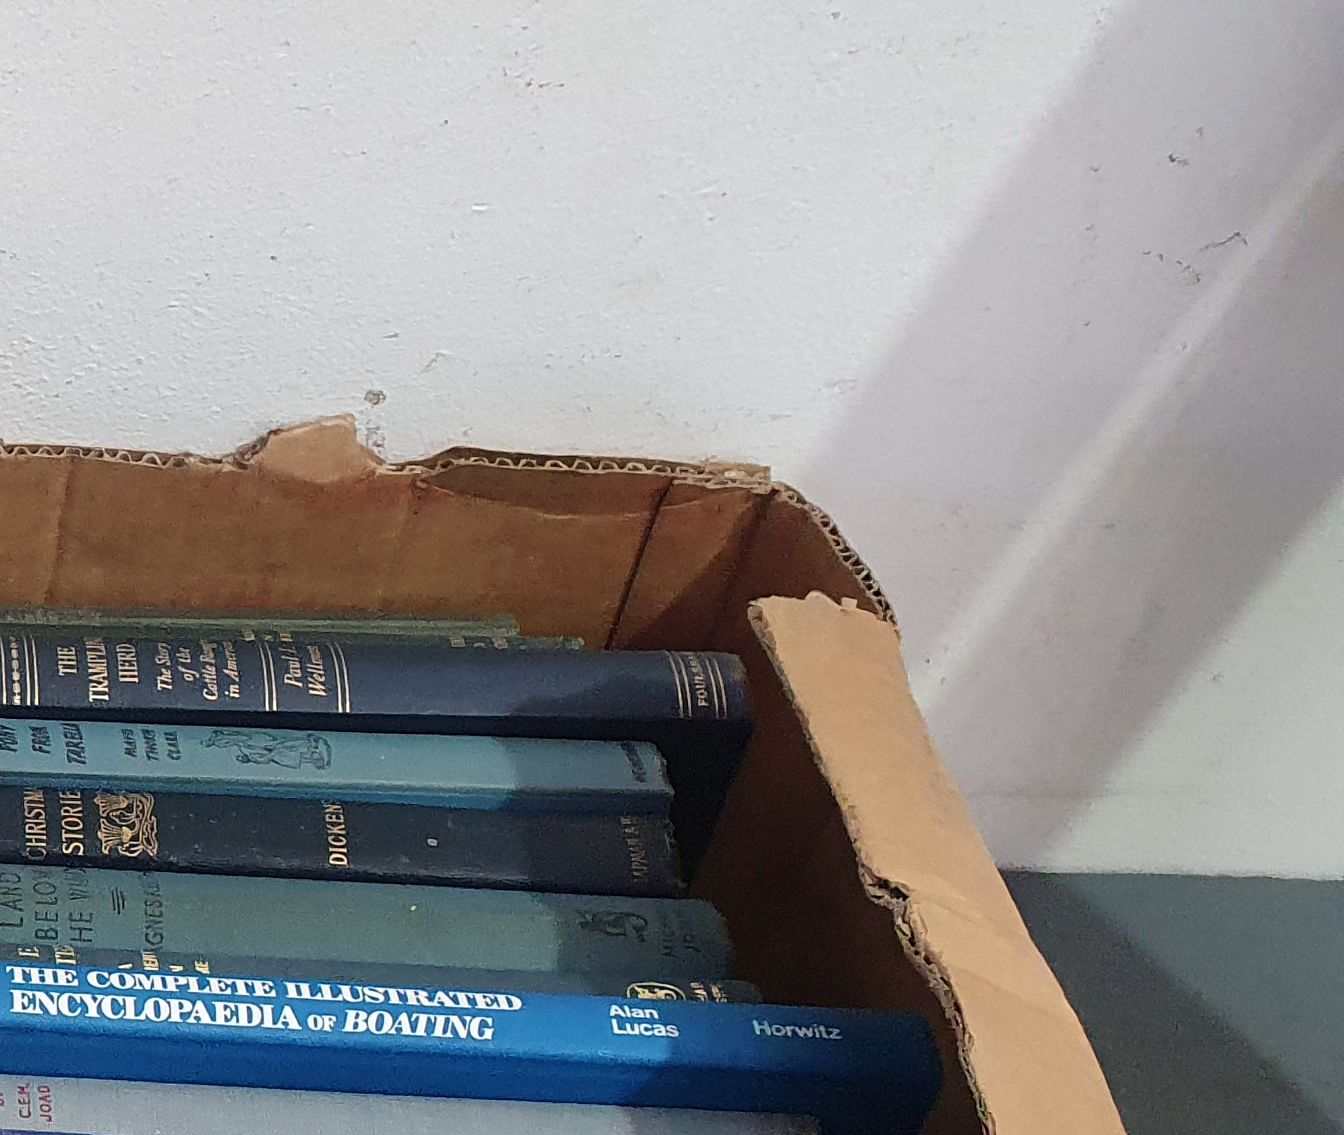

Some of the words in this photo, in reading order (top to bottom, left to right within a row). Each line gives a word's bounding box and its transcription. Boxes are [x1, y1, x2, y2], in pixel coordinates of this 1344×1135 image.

[56, 646, 79, 676] THE
[116, 642, 139, 684] HERD
[176, 647, 192, 663] the
[156, 668, 173, 690] The
[178, 666, 200, 682] of
[202, 664, 219, 701] Cattle
[281, 655, 303, 688] Paul
[224, 683, 241, 698] in
[30, 725, 51, 755] FROM
[0, 871, 25, 928] LAND
[5, 965, 79, 989] THE
[86, 970, 277, 999] COMPLETE
[284, 981, 524, 1011] ILLUSTRATED
[10, 989, 302, 1032] ENCYCLOPAEDIA
[306, 1013, 337, 1033] OF
[342, 1010, 496, 1042] BOATING
[608, 1004, 660, 1020] Alan
[611, 1019, 680, 1040] Lucas
[751, 1019, 844, 1041] Horwitz
[38, 1084, 53, 1123] JOAD
